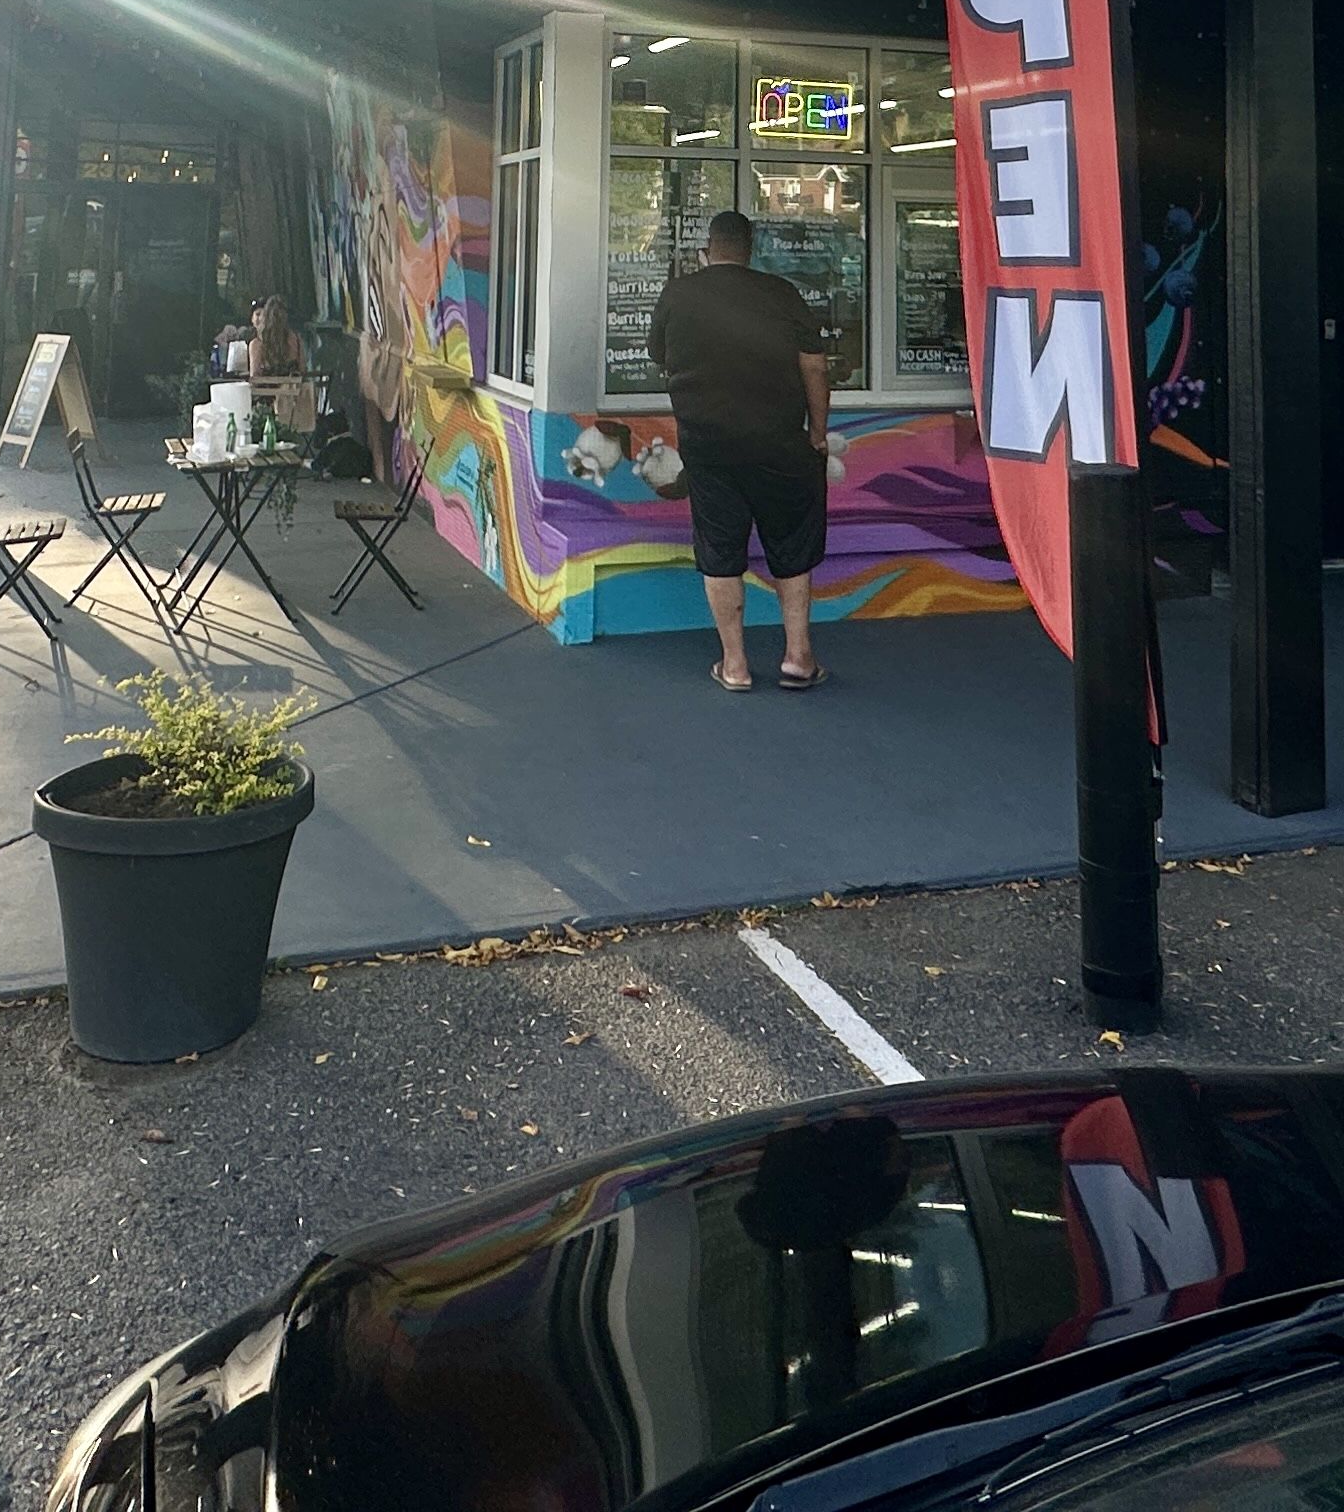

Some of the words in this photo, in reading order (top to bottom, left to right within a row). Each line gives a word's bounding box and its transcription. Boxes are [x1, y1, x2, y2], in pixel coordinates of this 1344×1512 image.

[762, 92, 847, 130] OPEN
[605, 346, 652, 364] Quesad
[900, 349, 915, 361] NO
[916, 349, 942, 361] CASH
